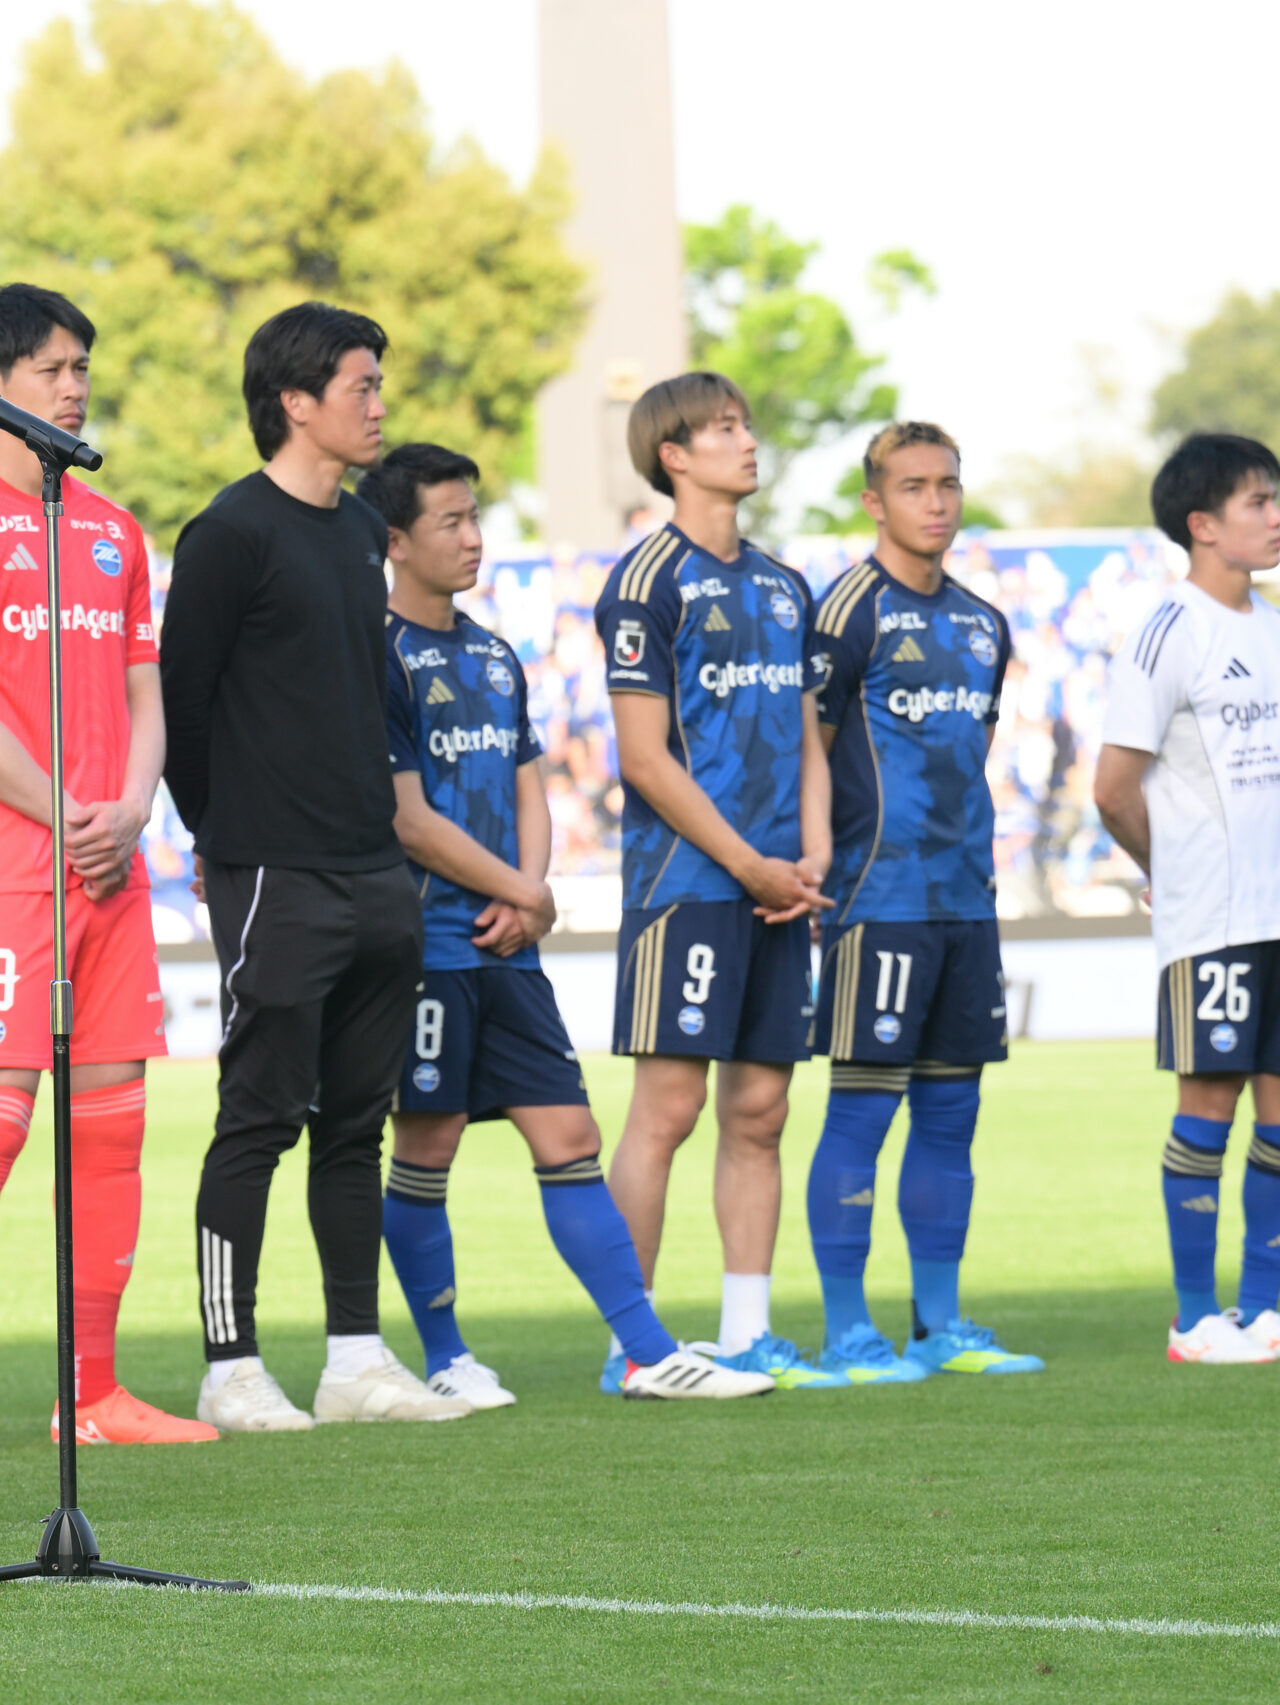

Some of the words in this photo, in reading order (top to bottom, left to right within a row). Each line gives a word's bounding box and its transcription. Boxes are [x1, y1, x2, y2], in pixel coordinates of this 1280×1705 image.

[2, 603, 126, 640] CybrAgent
[682, 943, 717, 1005] 9
[876, 951, 913, 1014] 11
[1197, 961, 1252, 1023] 26
[415, 999, 445, 1060] 8
